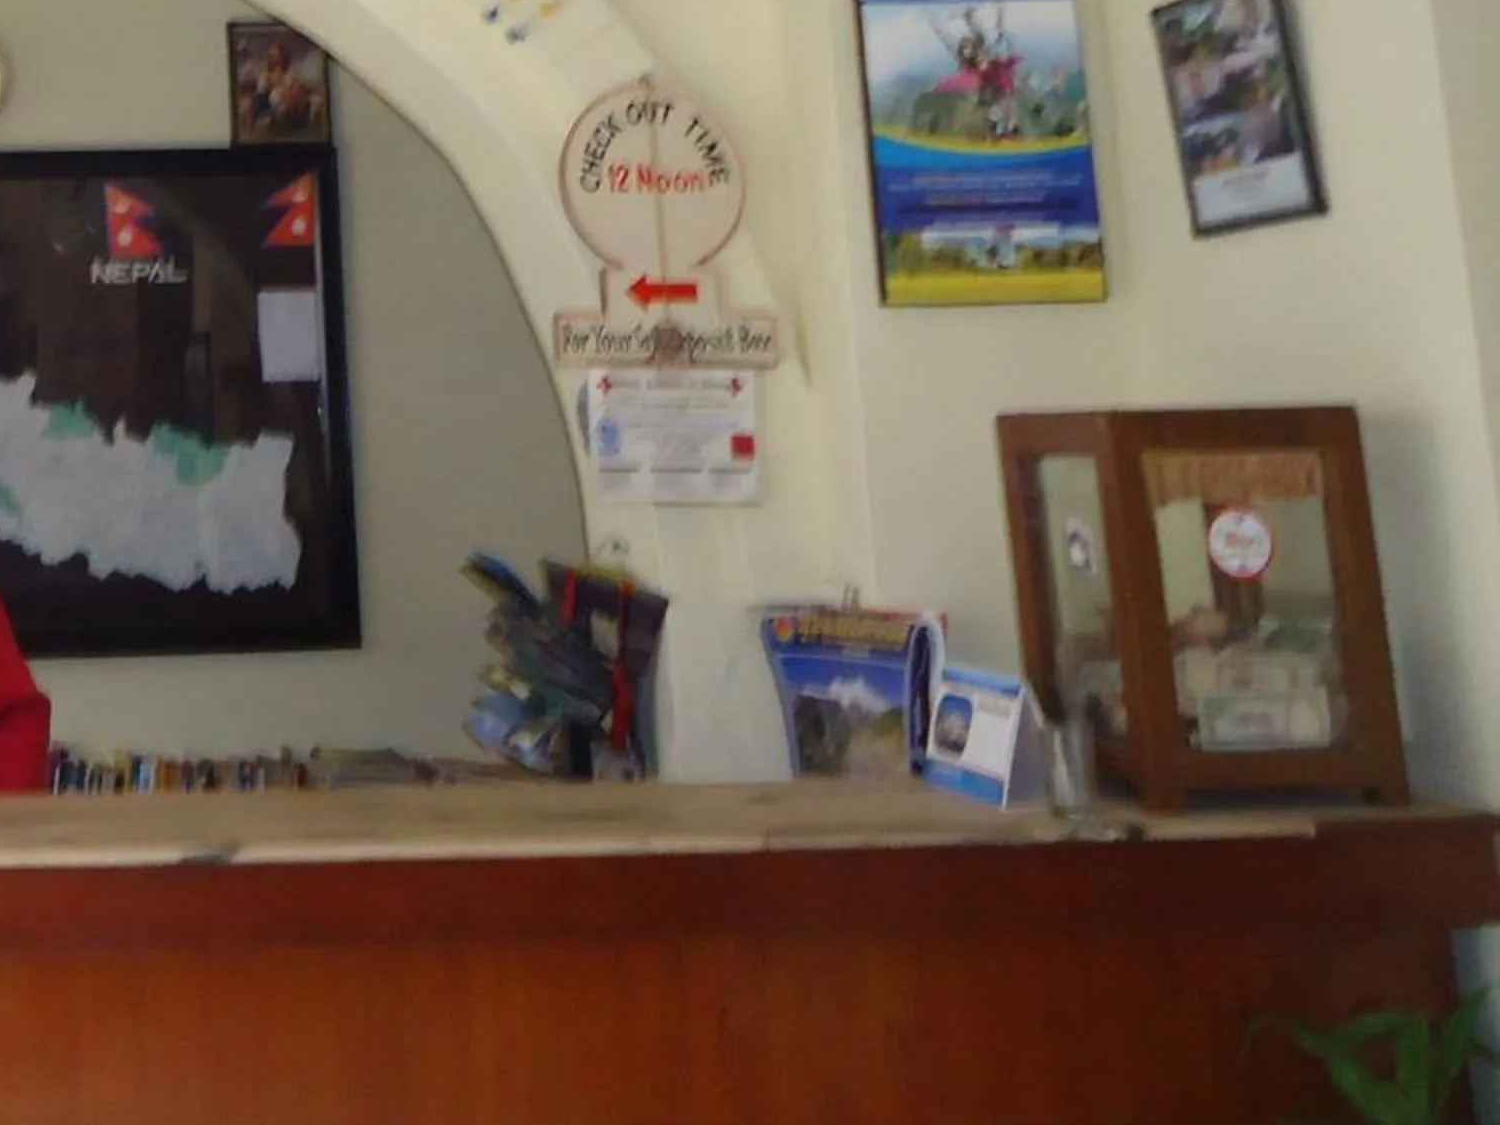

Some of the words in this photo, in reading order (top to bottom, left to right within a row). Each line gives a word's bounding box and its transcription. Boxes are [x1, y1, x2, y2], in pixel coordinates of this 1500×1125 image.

[579, 112, 622, 193] CHECK
[626, 99, 674, 125] OUT
[684, 116, 729, 187] TIME
[608, 161, 629, 193] 12
[637, 162, 704, 194] Noon
[90, 256, 188, 284] NEPAL
